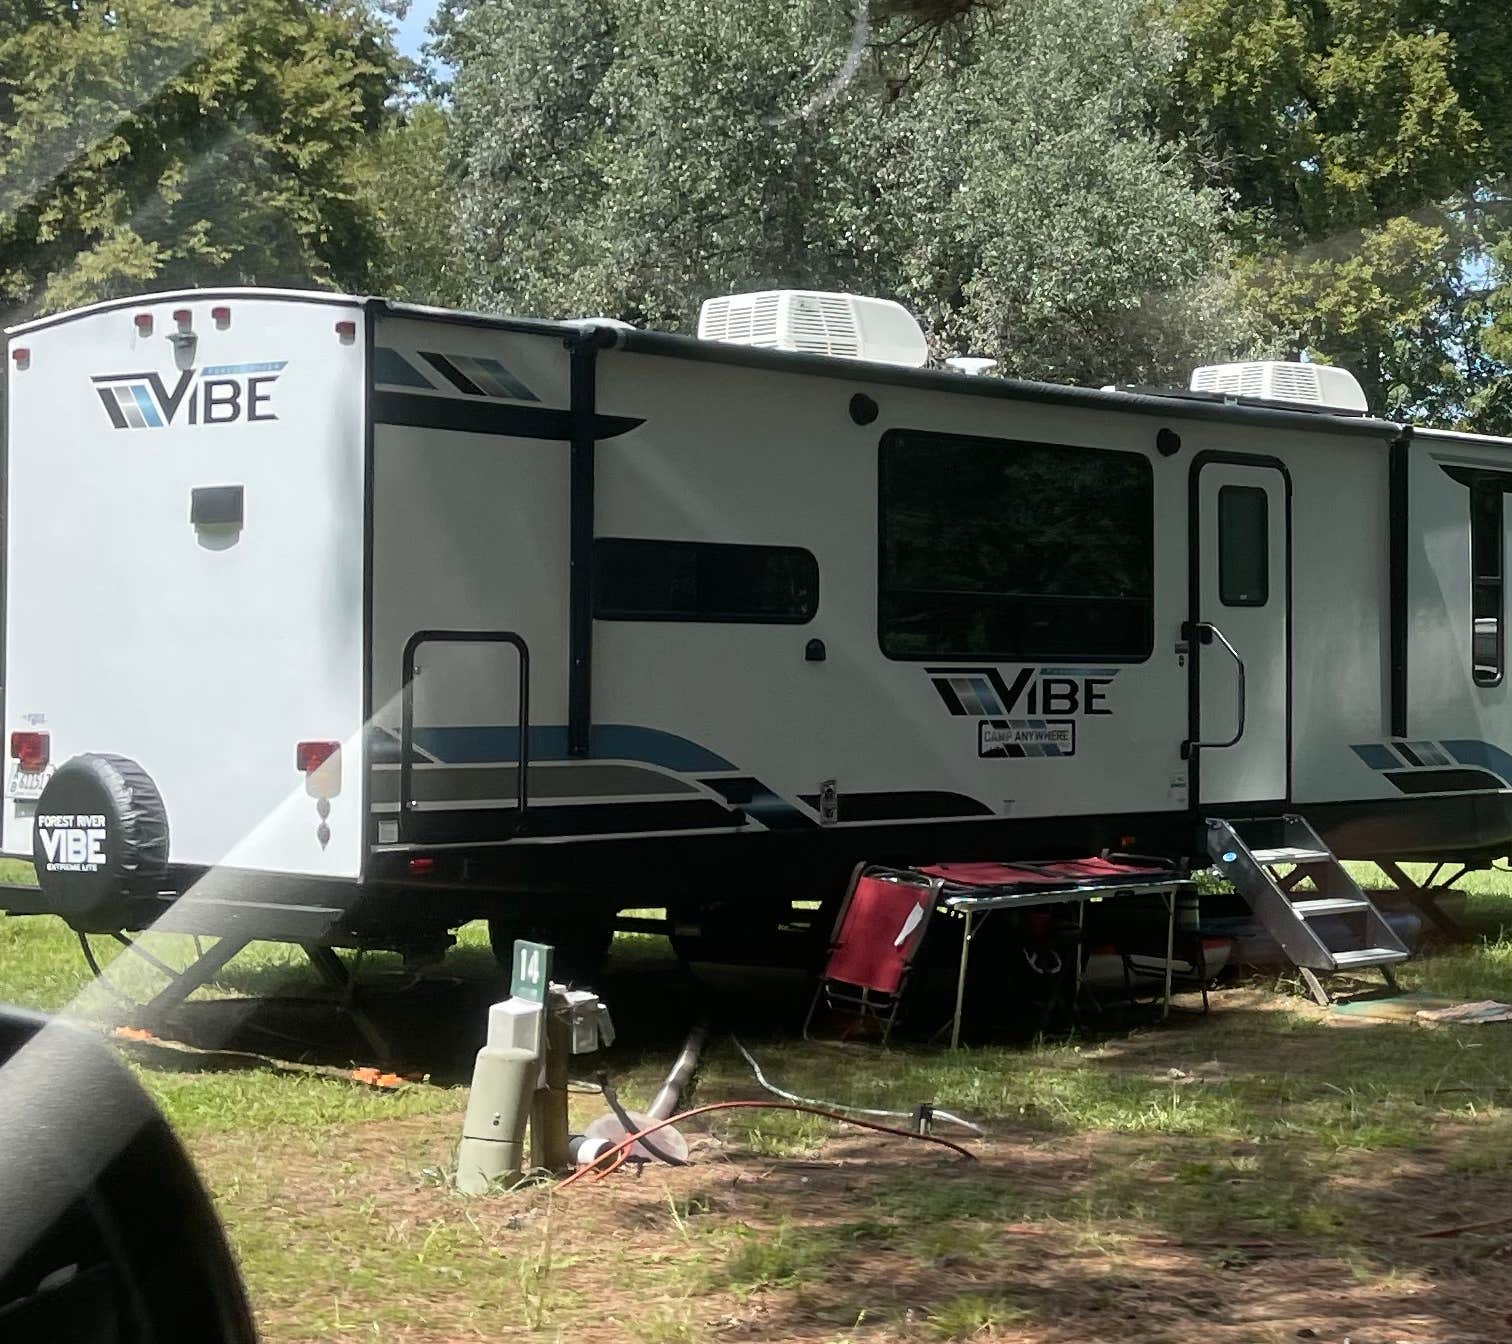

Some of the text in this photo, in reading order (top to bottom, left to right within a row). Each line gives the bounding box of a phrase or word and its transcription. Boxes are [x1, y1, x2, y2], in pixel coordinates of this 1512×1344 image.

[90, 368, 281, 428] VIBE
[923, 667, 1115, 716] VIBE
[1014, 729, 1070, 742] ANYWHERE
[38, 814, 106, 828] FOREST RIVER
[39, 828, 107, 864] VIBE
[520, 948, 539, 984] 14
